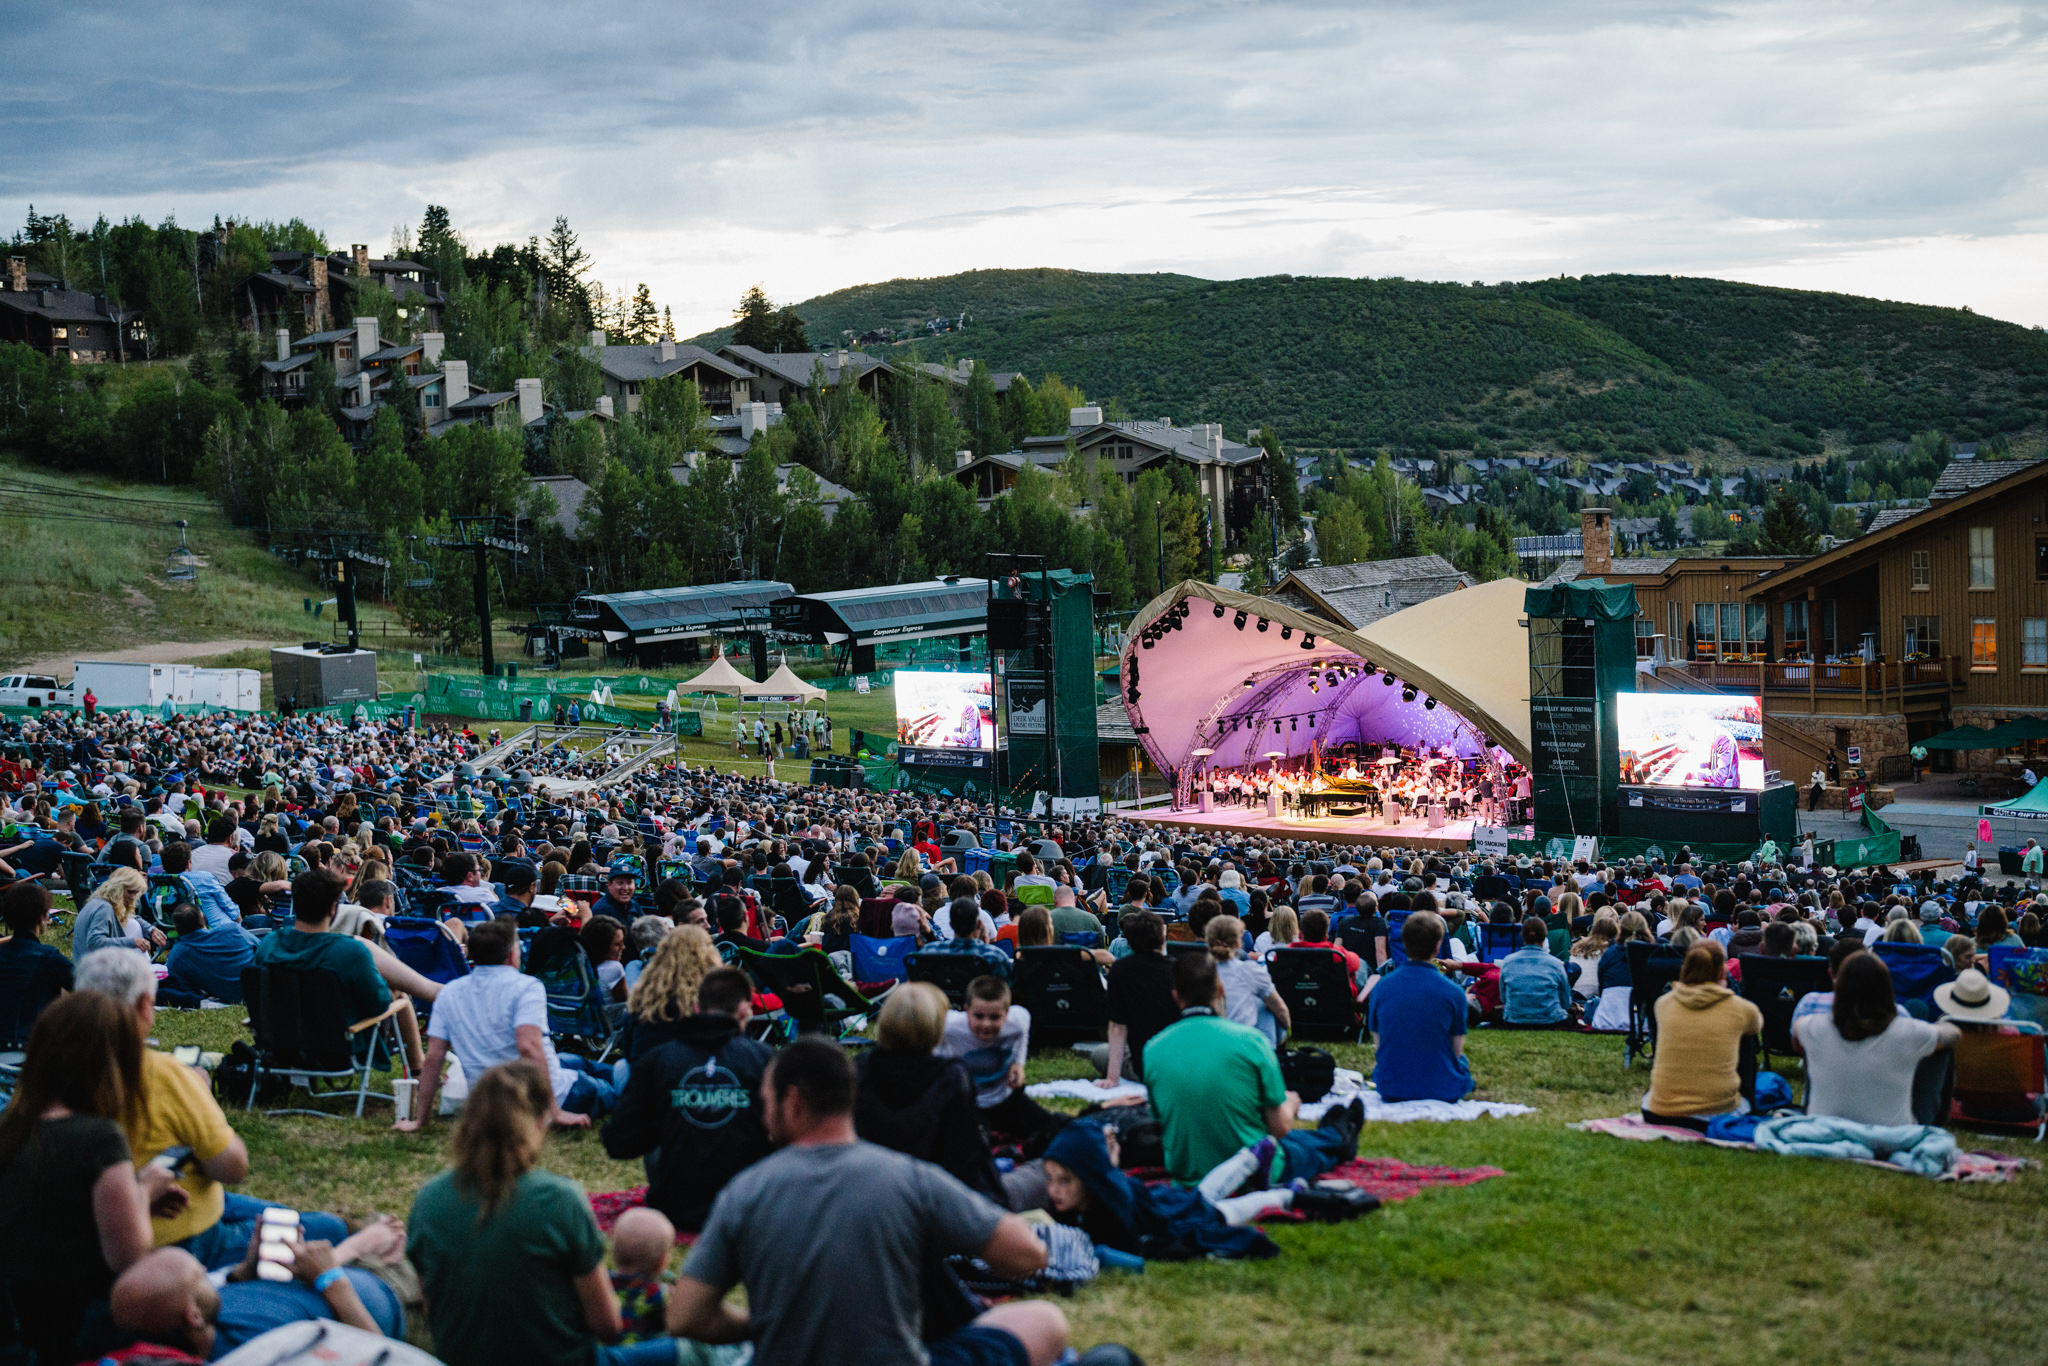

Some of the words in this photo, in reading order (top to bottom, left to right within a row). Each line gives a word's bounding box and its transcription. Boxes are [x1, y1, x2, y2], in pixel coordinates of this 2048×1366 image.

[654, 627, 669, 635] Silver
[686, 624, 707, 632] Express
[873, 628, 900, 636] Carpenter
[902, 625, 924, 633] Express
